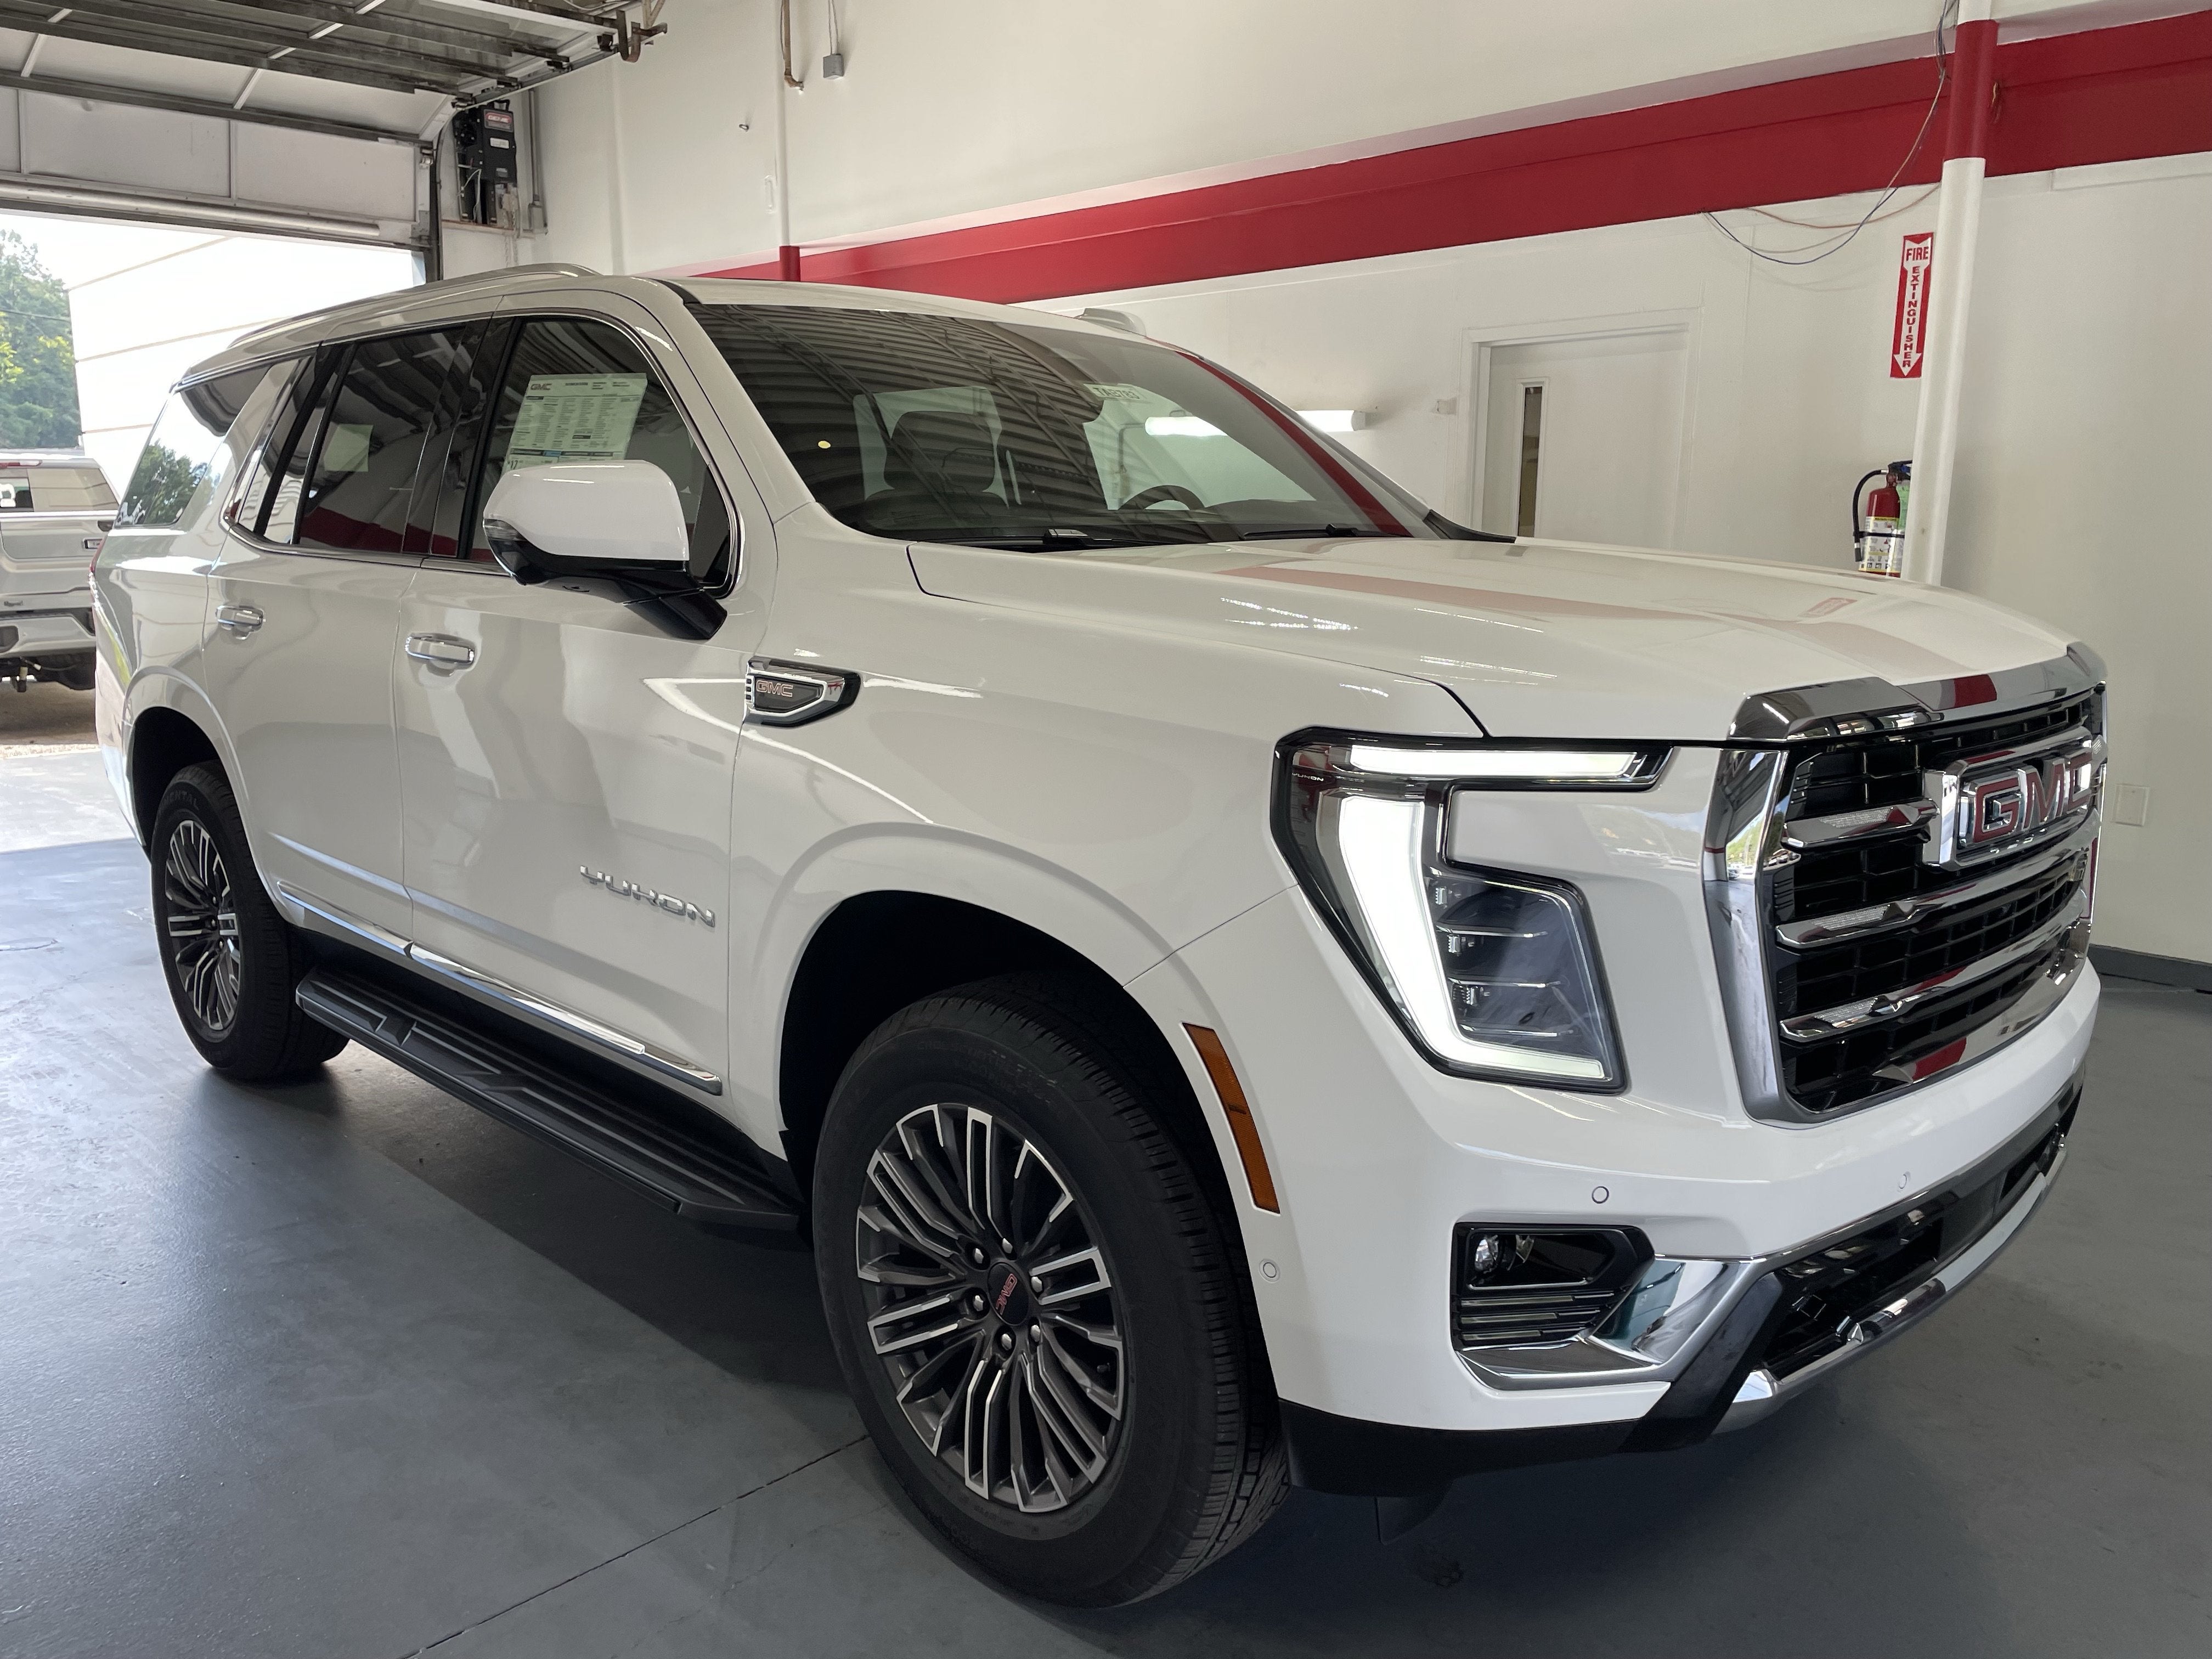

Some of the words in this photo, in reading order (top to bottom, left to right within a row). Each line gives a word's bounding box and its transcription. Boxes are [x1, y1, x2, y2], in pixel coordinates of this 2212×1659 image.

[1906, 246, 1929, 261] FIRE
[1903, 266, 1920, 368] EXTINGUISHER
[756, 679, 794, 698] GMC
[1292, 772, 1324, 782] YUKON
[1970, 748, 2093, 843] GMC
[580, 865, 715, 927] YUKON
[996, 1273, 1018, 1316] GMC
